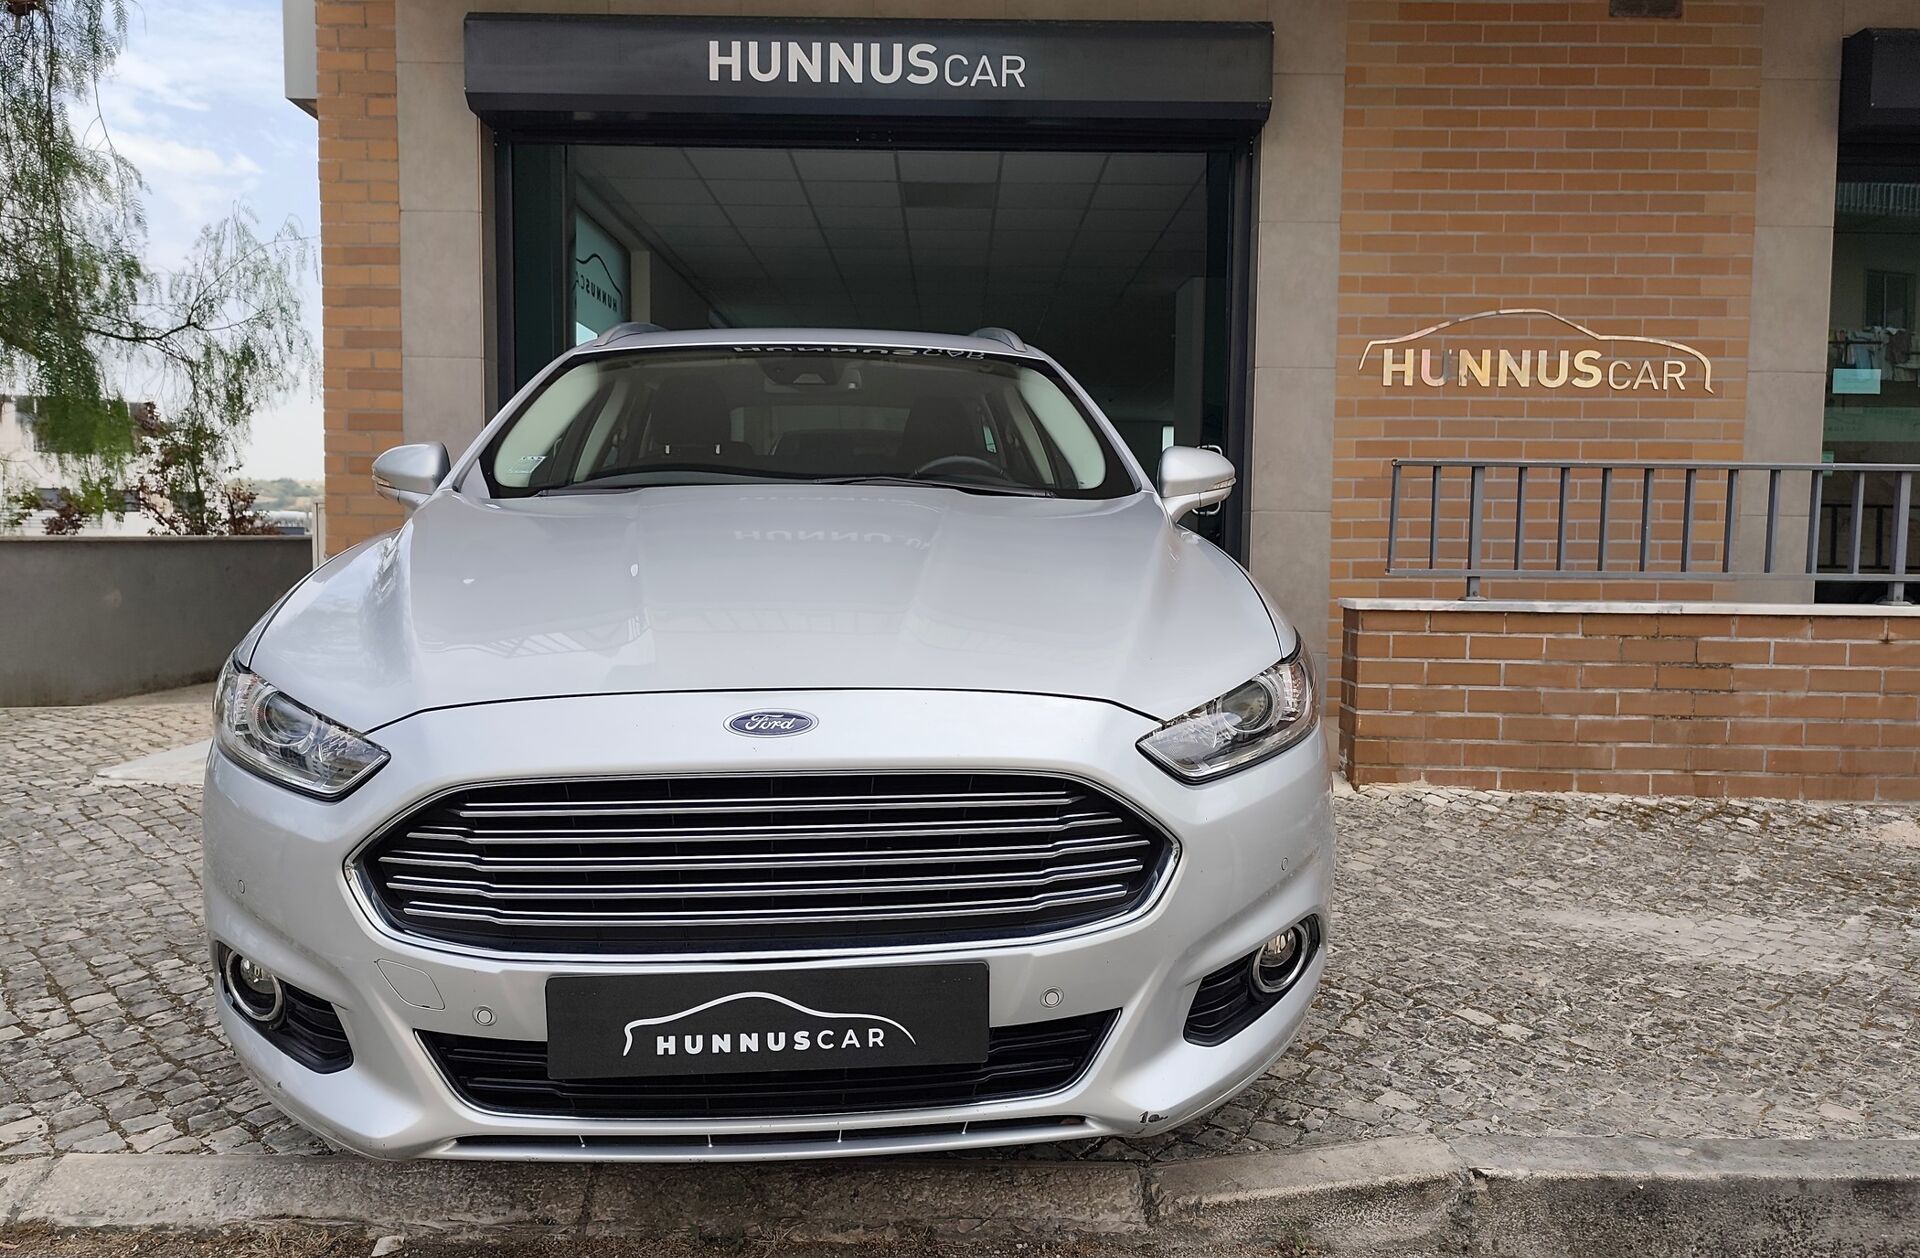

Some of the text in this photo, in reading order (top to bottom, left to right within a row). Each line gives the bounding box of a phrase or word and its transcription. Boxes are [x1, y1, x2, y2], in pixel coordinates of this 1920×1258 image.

[707, 40, 1027, 89] HUNNUSCAR
[1381, 348, 1687, 391] HUNNUSCAR
[745, 713, 797, 731] Ford
[656, 1027, 885, 1056] HUNNUSCAR
